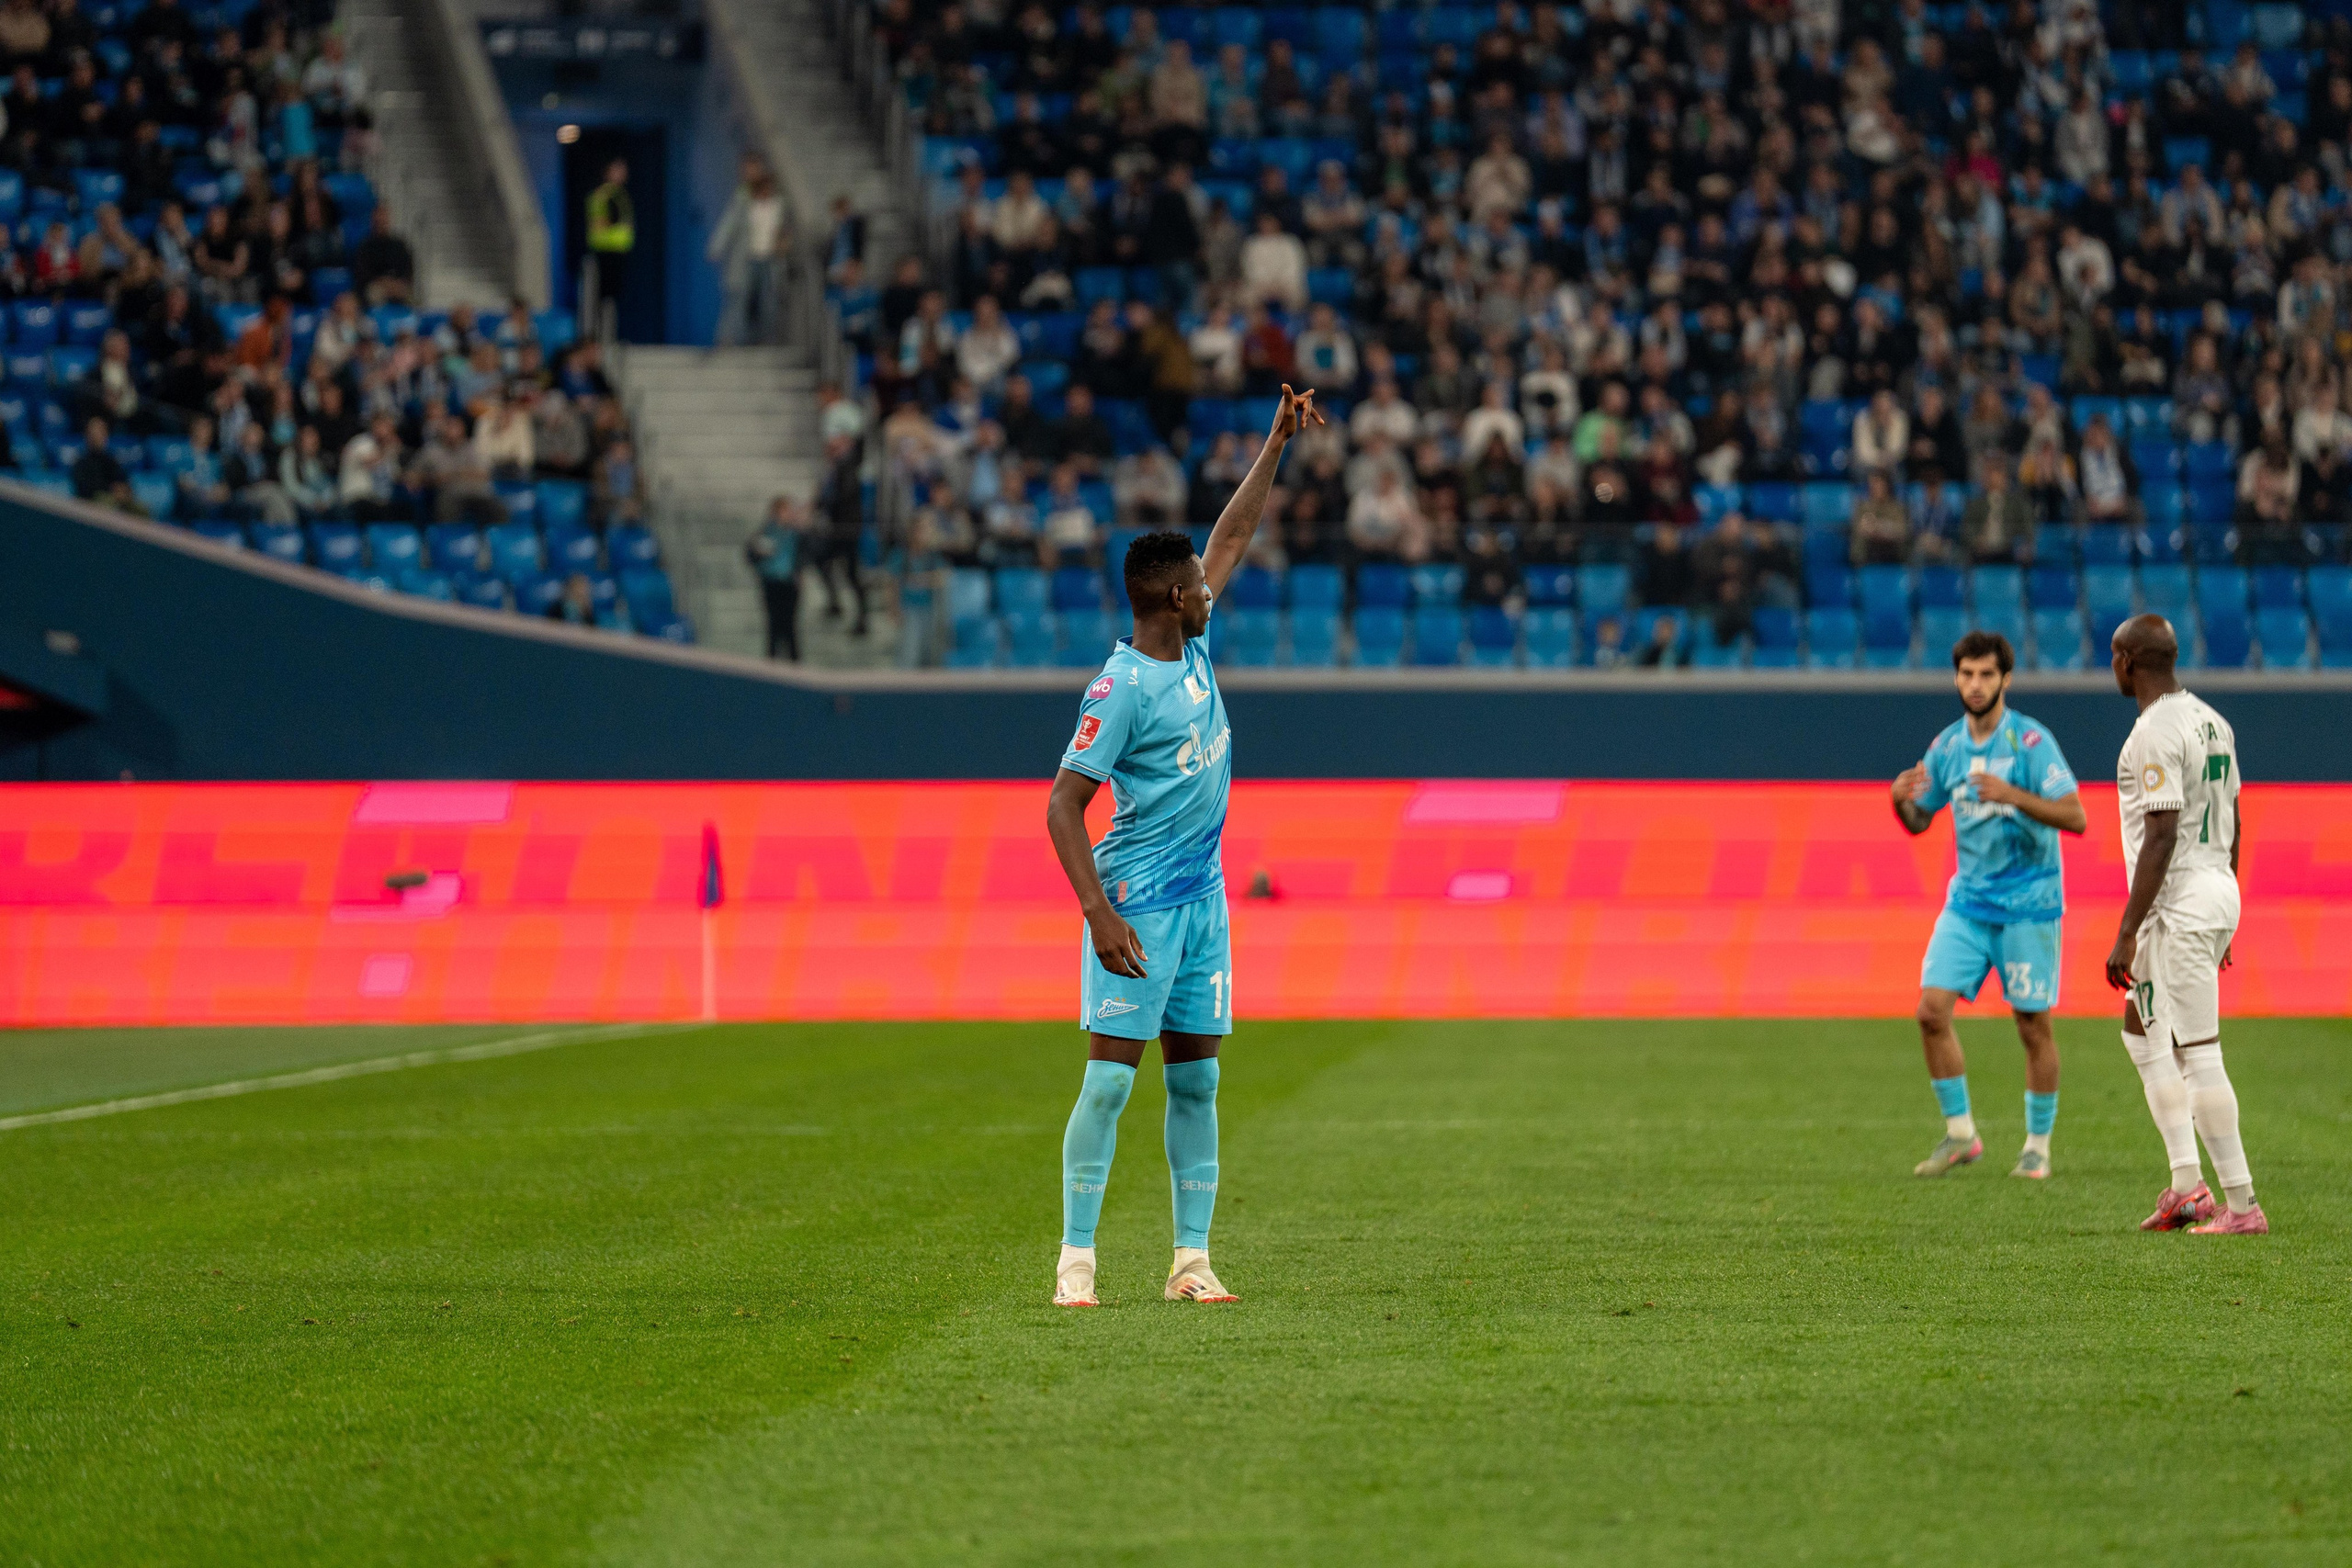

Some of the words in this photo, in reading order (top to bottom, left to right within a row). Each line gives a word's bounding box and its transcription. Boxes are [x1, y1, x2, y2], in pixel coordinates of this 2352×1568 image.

[1092, 681, 1111, 693] wb
[1209, 971, 1232, 1019] 11
[2007, 962, 2032, 999] 23
[2135, 980, 2154, 1019] 17
